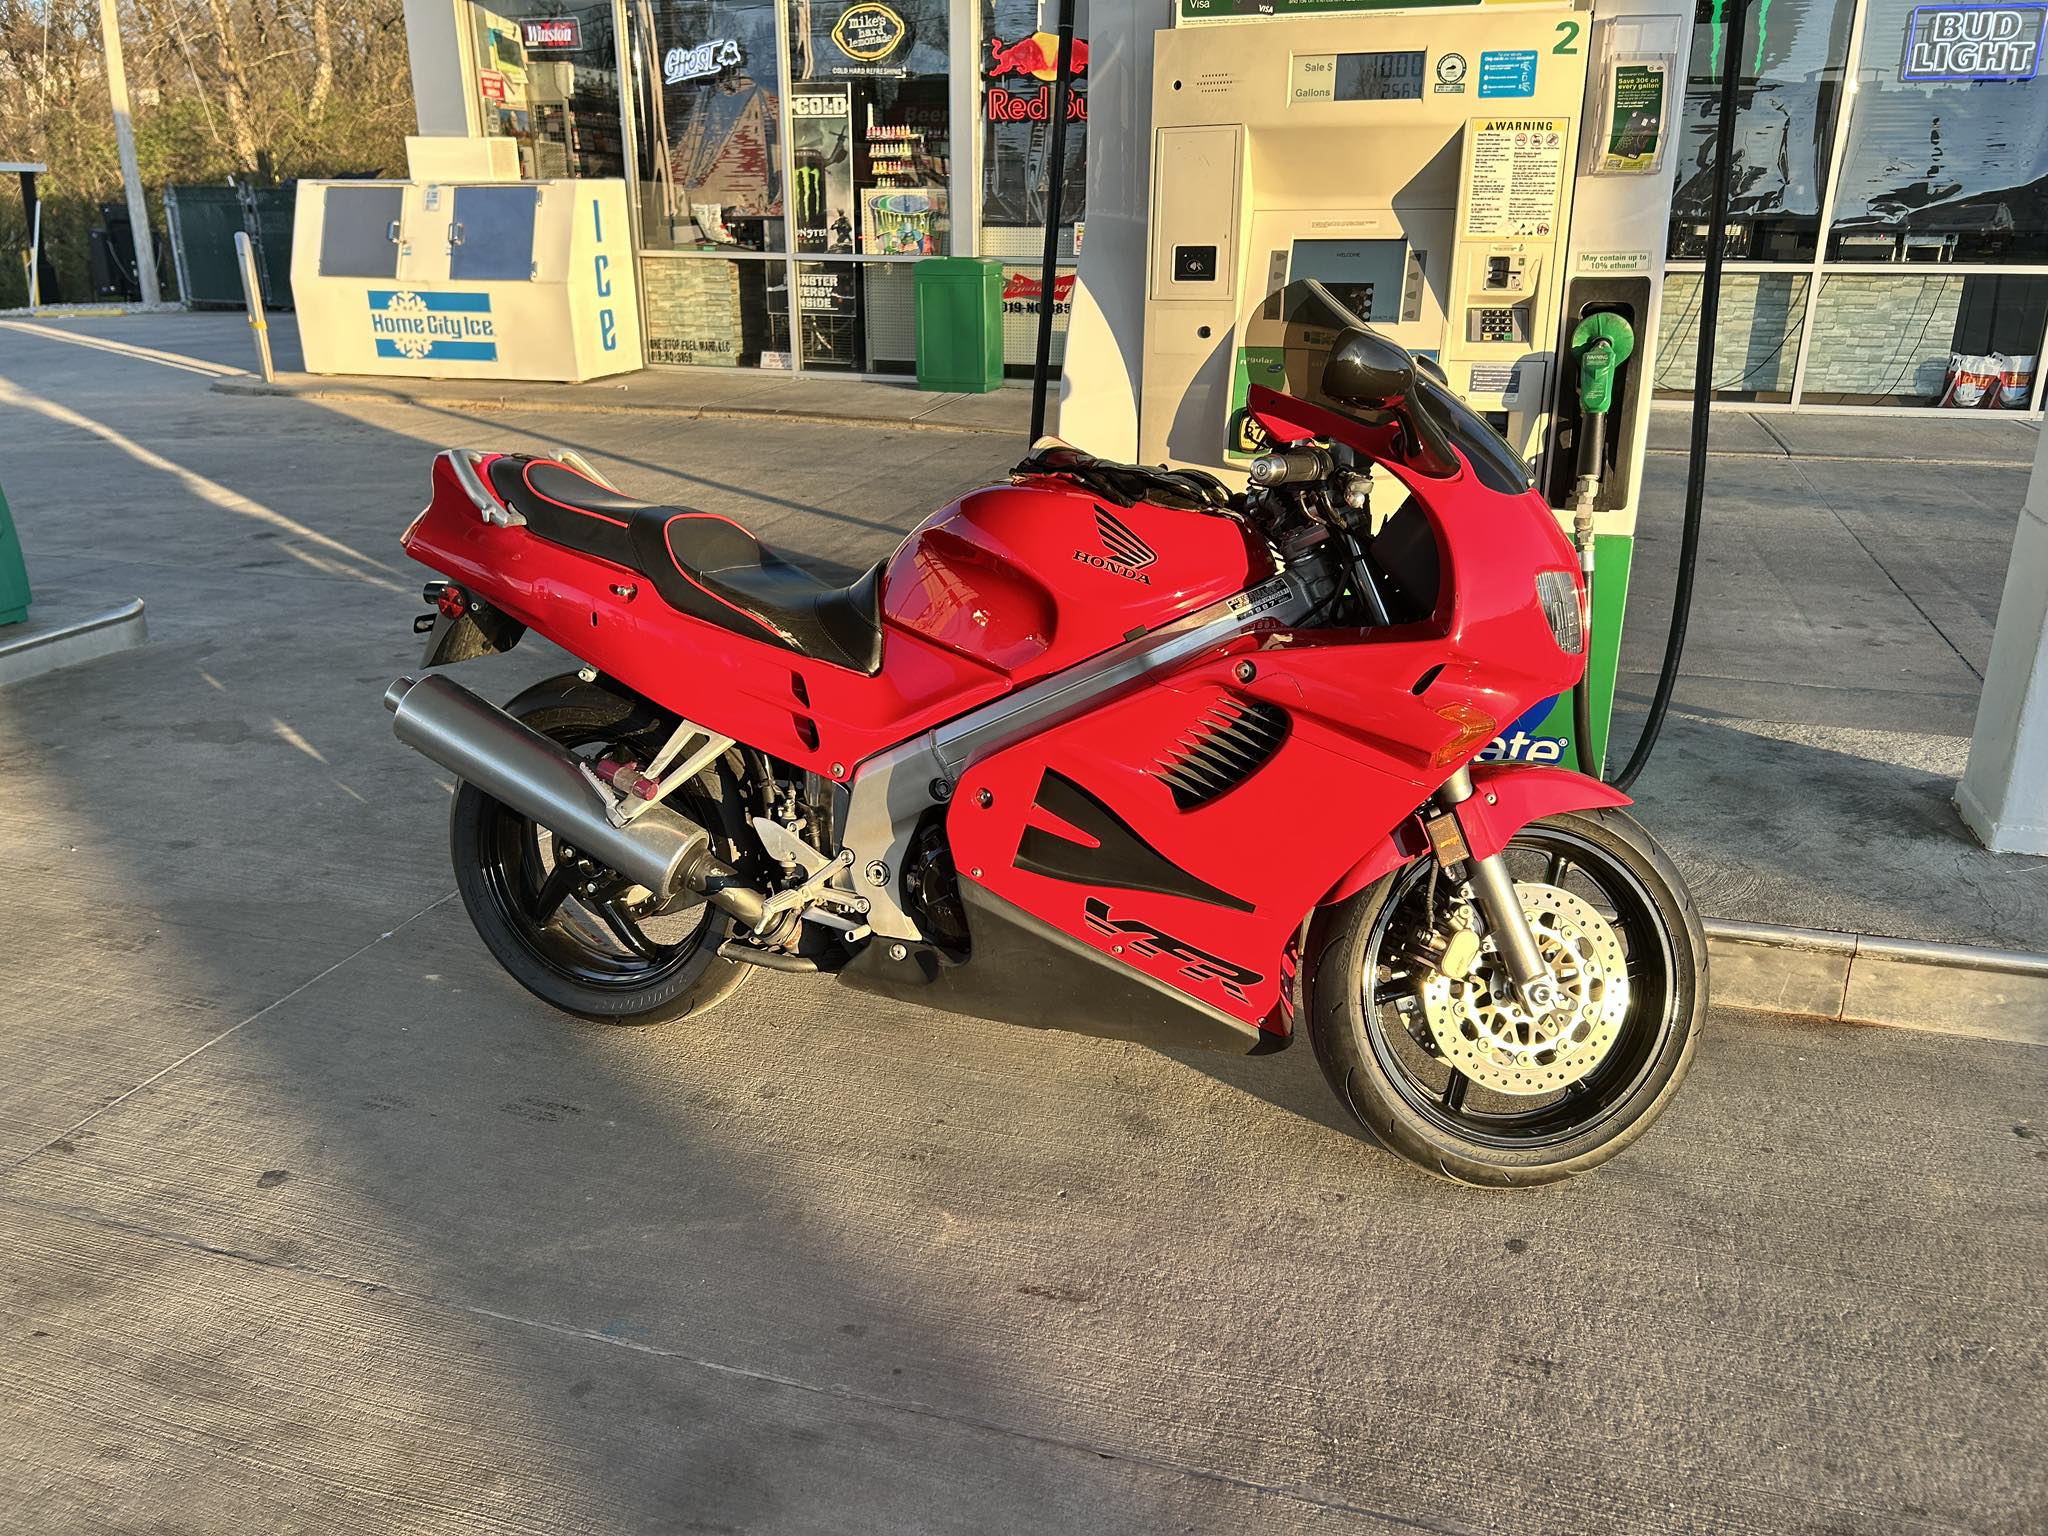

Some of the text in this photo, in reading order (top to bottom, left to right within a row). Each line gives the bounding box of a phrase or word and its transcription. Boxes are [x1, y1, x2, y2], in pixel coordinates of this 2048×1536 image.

[1189, 0, 1210, 9] Visa
[1258, 4, 1273, 13] VISA
[848, 14, 887, 29] mike's
[1933, 10, 2022, 42] BUD
[527, 25, 572, 42] Winston
[858, 27, 885, 38] hard
[1552, 21, 1579, 56] 2
[847, 34, 893, 48] lemonade
[664, 39, 724, 80] GHOST
[1911, 41, 2036, 72] LIGHT
[832, 67, 902, 76] COLD HARD REFRESHING
[1304, 62, 1333, 73] Sale $
[1294, 87, 1331, 98] Gallons
[795, 97, 847, 115] COLD
[989, 86, 1048, 120] Red
[1495, 121, 1553, 131] WARNING
[1582, 254, 1598, 262] May
[1599, 253, 1626, 261] contain
[1628, 255, 1637, 263] up
[800, 276, 838, 287] NSTER
[372, 313, 494, 340] Home City Ice
[1240, 356, 1274, 366] regular
[1072, 549, 1152, 586] HONDA
[1473, 731, 1560, 762] ate
[1084, 896, 1265, 1007] VFR
